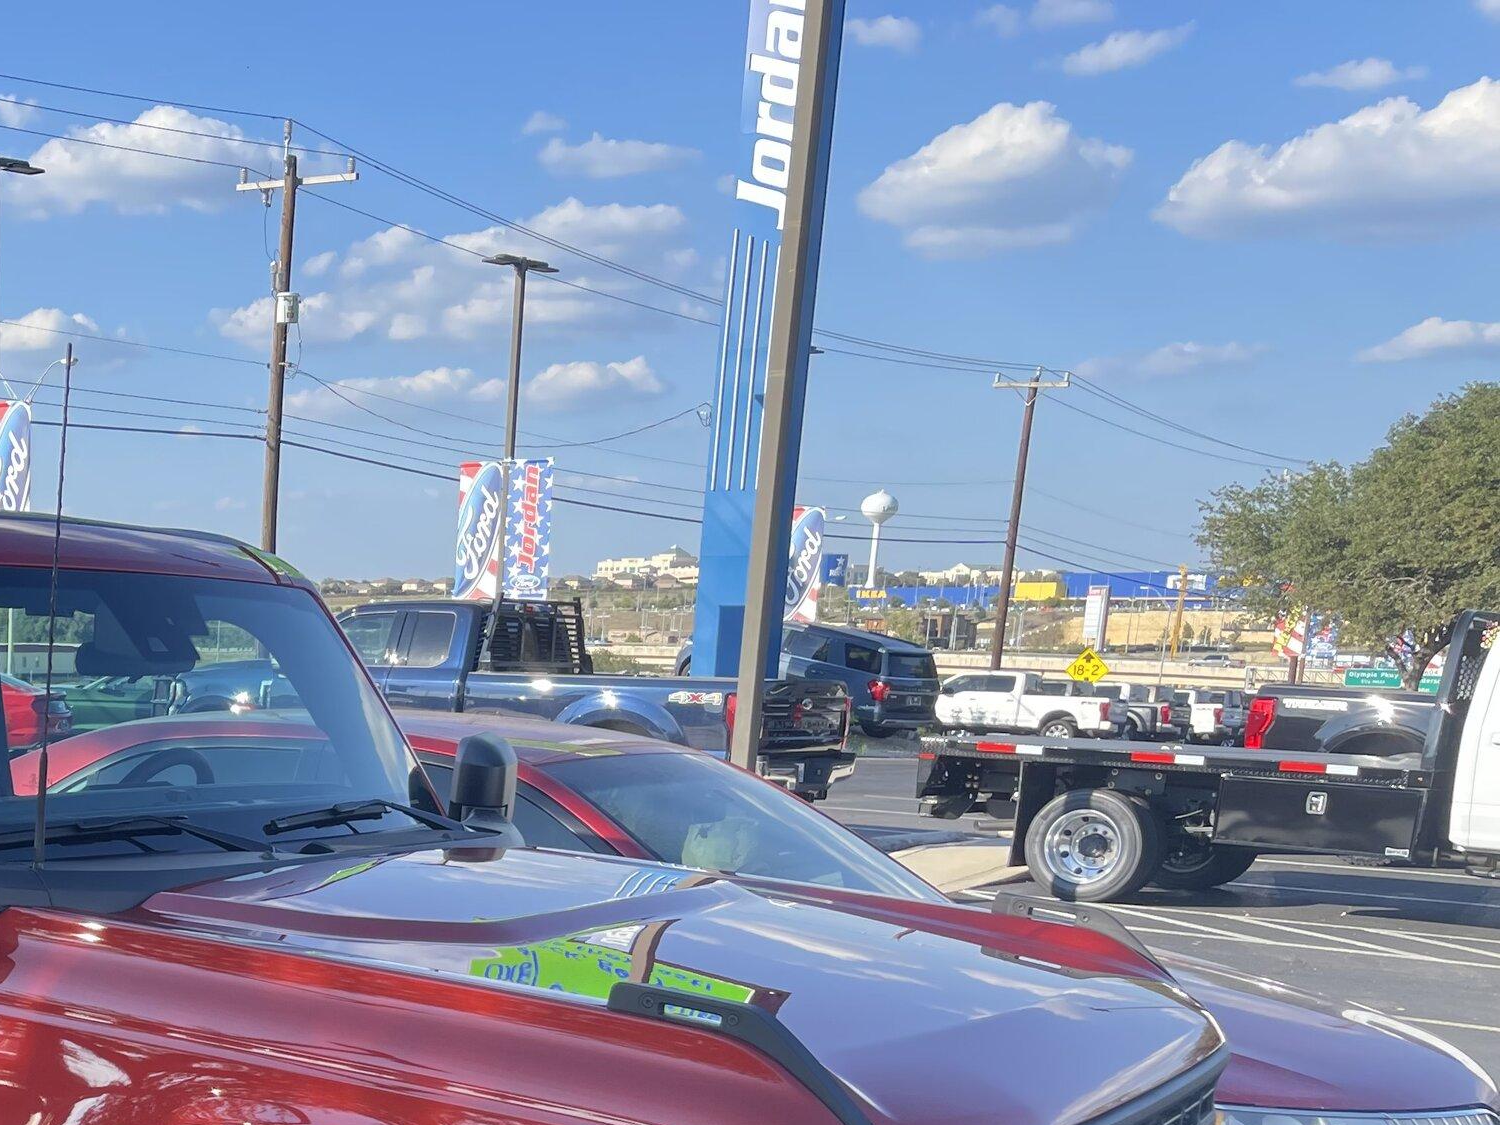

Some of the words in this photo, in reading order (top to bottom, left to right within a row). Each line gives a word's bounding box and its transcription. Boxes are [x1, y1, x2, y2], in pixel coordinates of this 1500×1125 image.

[736, 0, 805, 230] Jorda
[456, 485, 499, 580] Ford
[516, 465, 540, 574] Jordan
[856, 590, 887, 598] IKEA
[1349, 671, 1378, 679] Olympic
